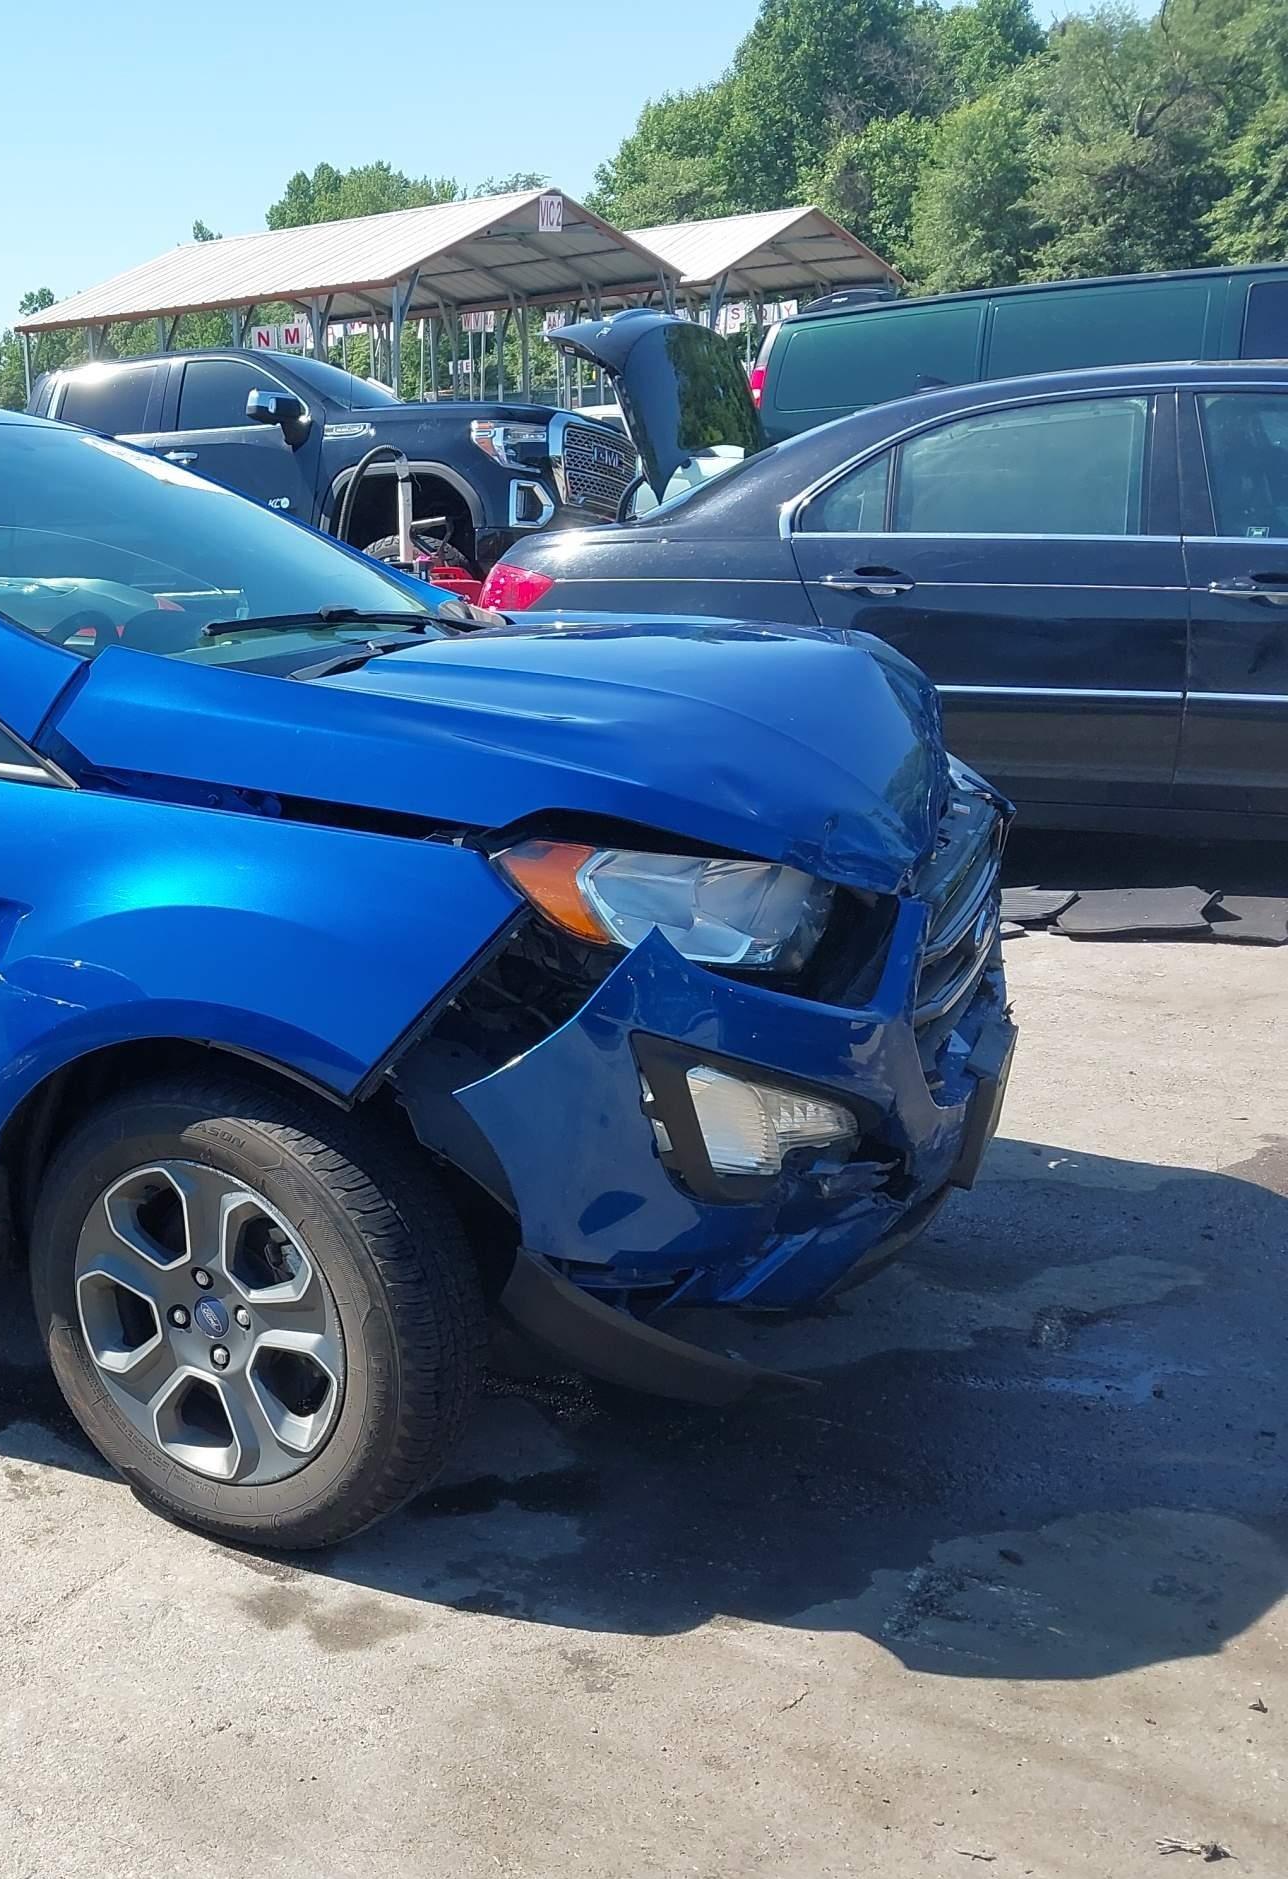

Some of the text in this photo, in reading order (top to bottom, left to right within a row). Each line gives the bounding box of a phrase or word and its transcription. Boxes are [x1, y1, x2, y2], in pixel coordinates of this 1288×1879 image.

[731, 307, 740, 320] S
[784, 303, 793, 317] Y
[257, 330, 270, 348] N
[284, 327, 300, 345] M
